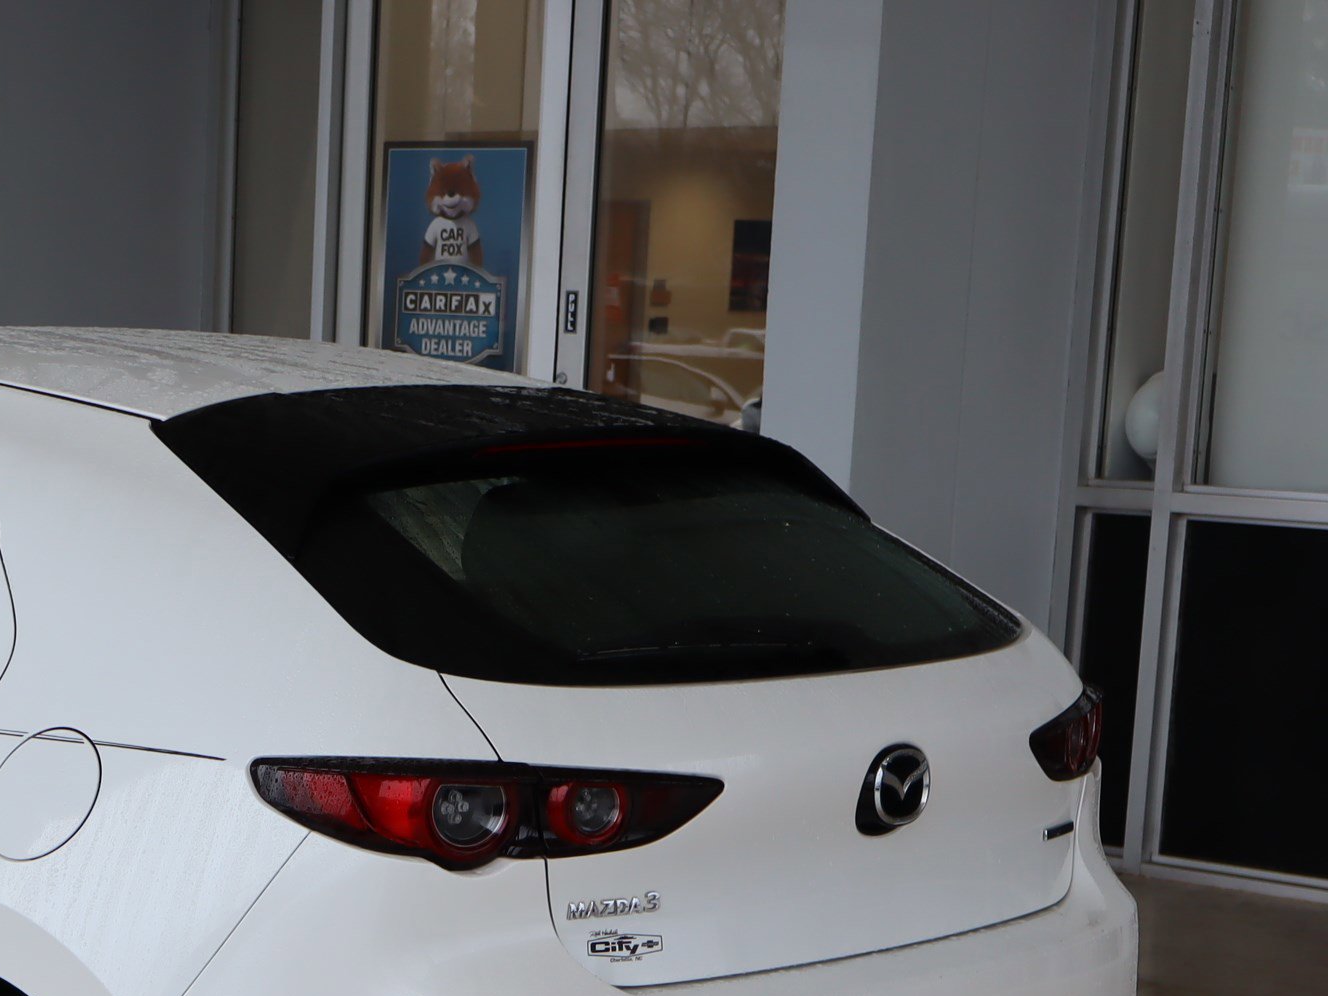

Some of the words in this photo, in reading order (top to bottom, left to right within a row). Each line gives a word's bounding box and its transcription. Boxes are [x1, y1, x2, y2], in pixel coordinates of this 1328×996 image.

[440, 228, 464, 242] CAR
[440, 243, 463, 256] FOX
[405, 292, 492, 315] CARFAX
[567, 293, 576, 331] PULL
[409, 318, 487, 337] ADVANTAGE
[422, 338, 472, 356] DEALER
[591, 940, 639, 954] City
